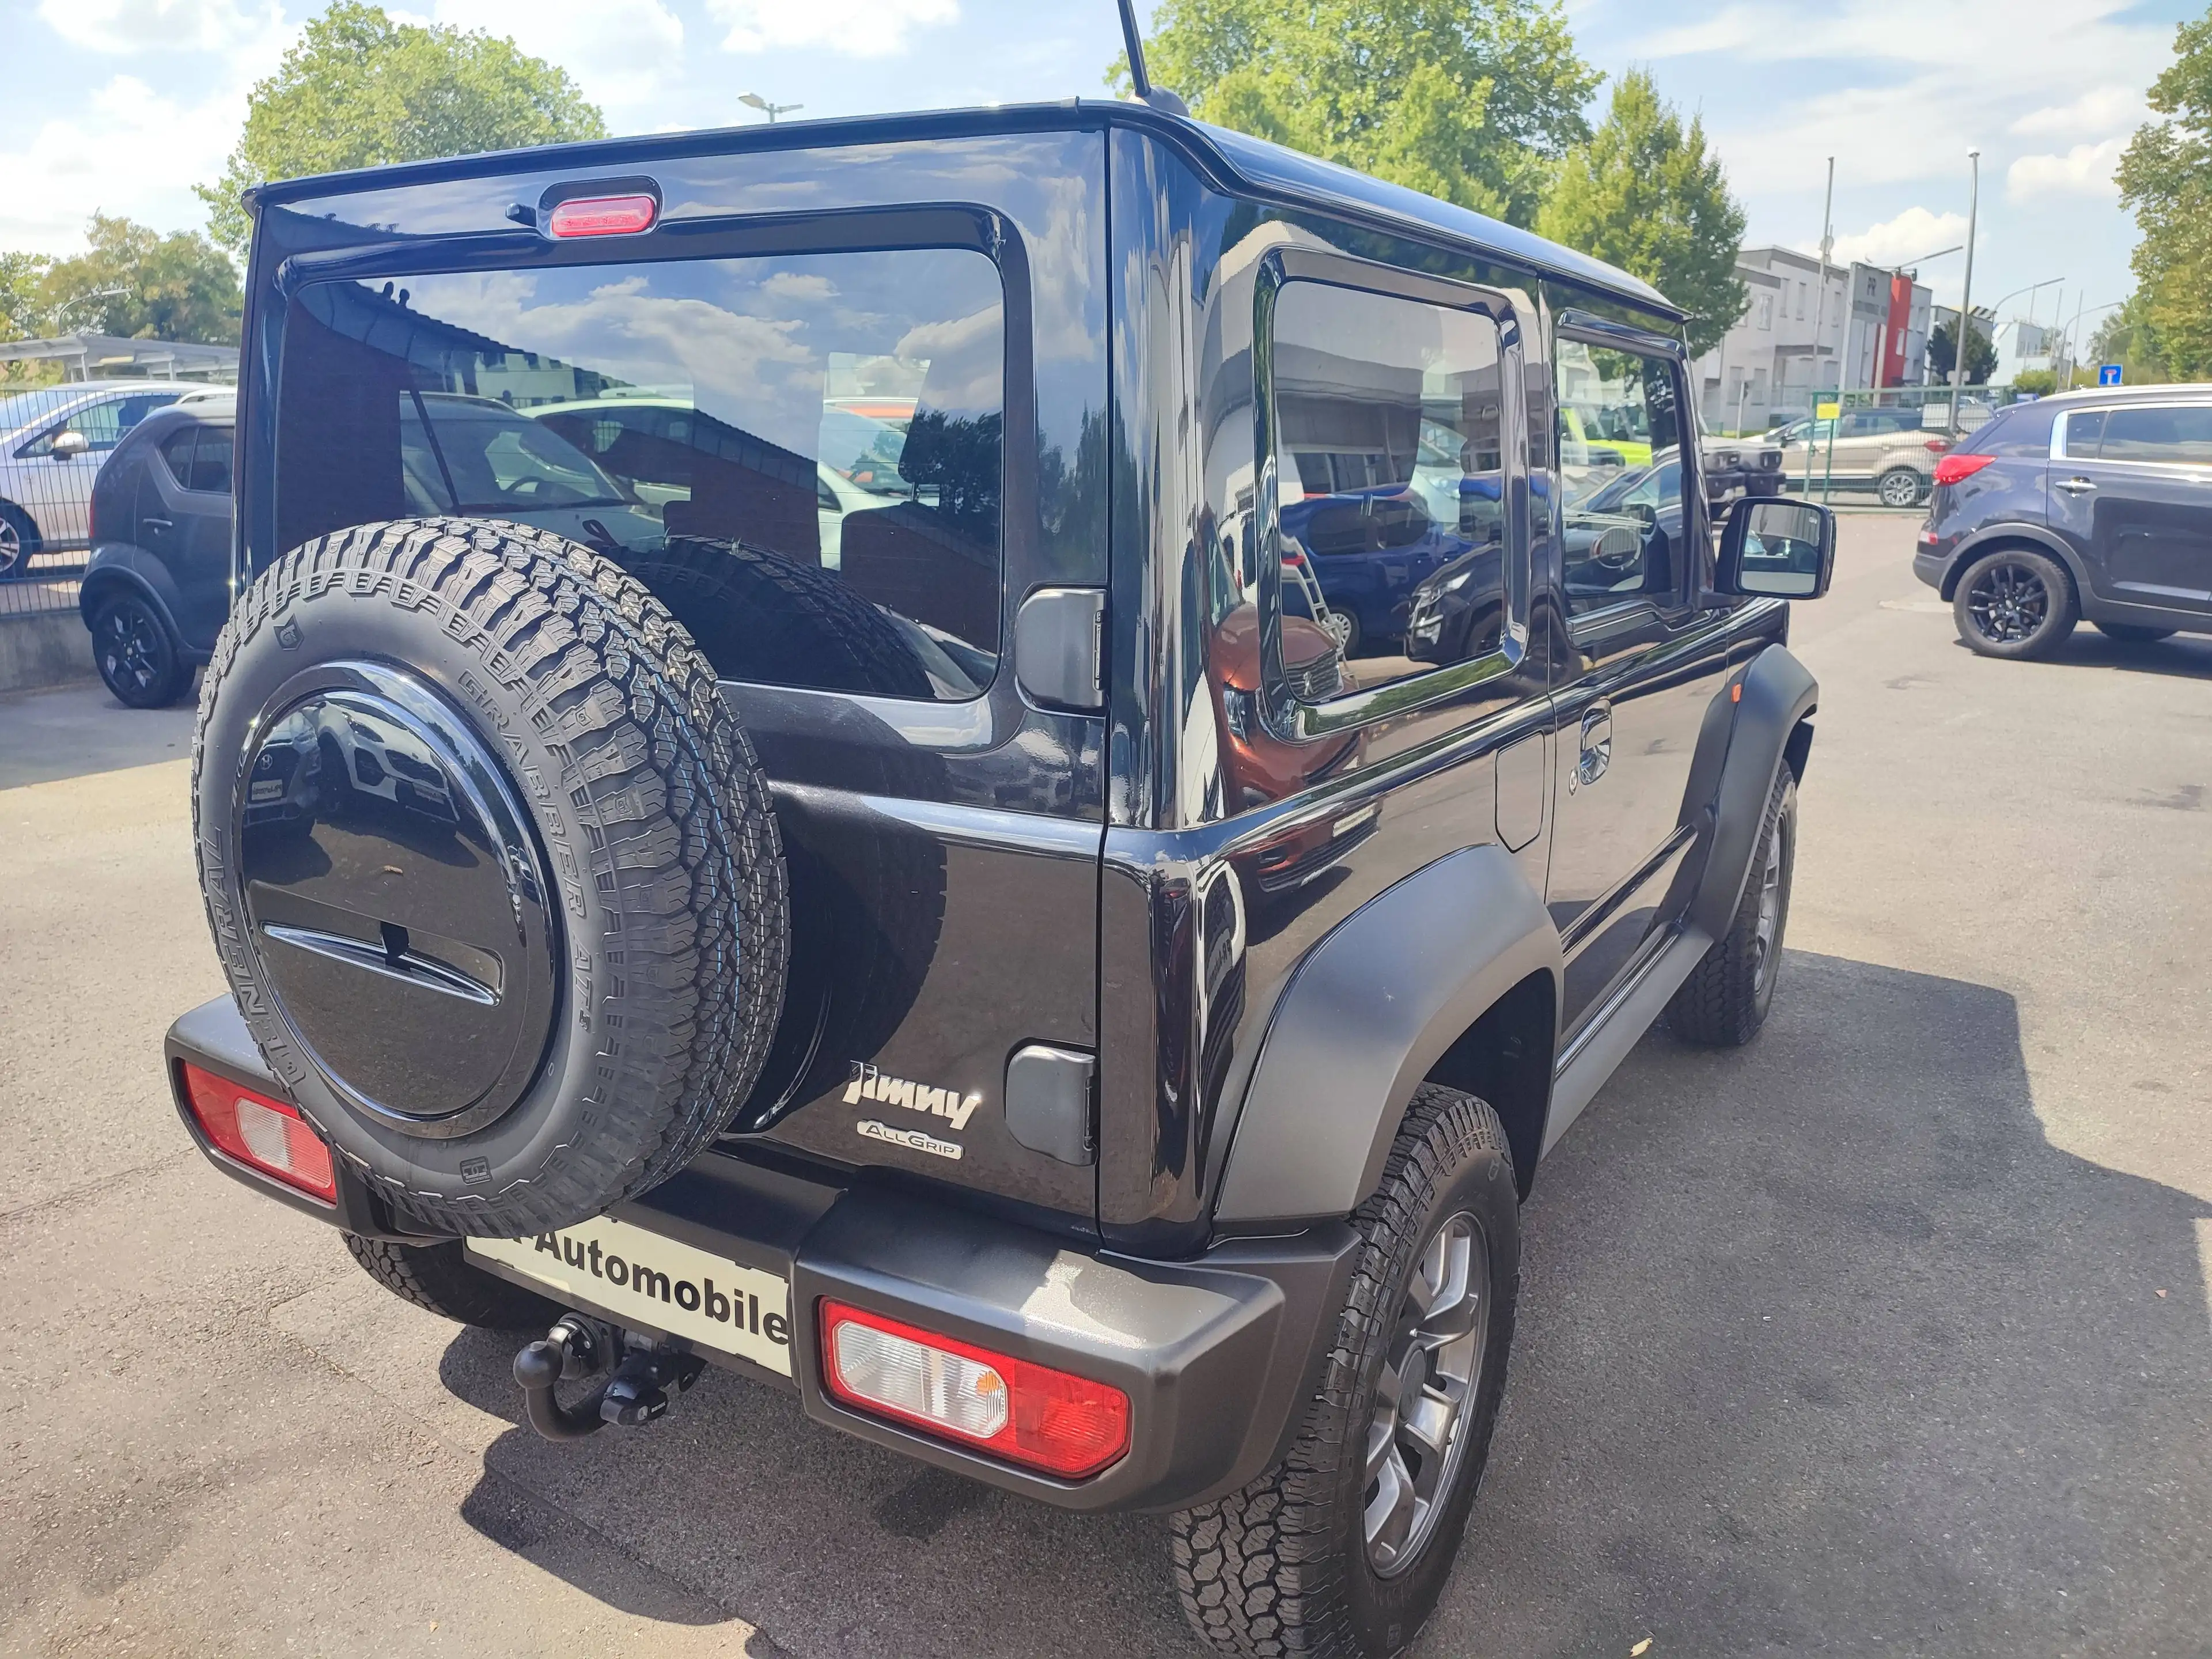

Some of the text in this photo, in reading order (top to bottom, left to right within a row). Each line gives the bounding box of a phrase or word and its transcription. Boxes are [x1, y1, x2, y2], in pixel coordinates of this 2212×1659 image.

[458, 668, 588, 919] GRABBER
[203, 826, 306, 1086] GENERAL
[842, 1059, 982, 1131] Jimny
[513, 1231, 788, 1346] Automobile
